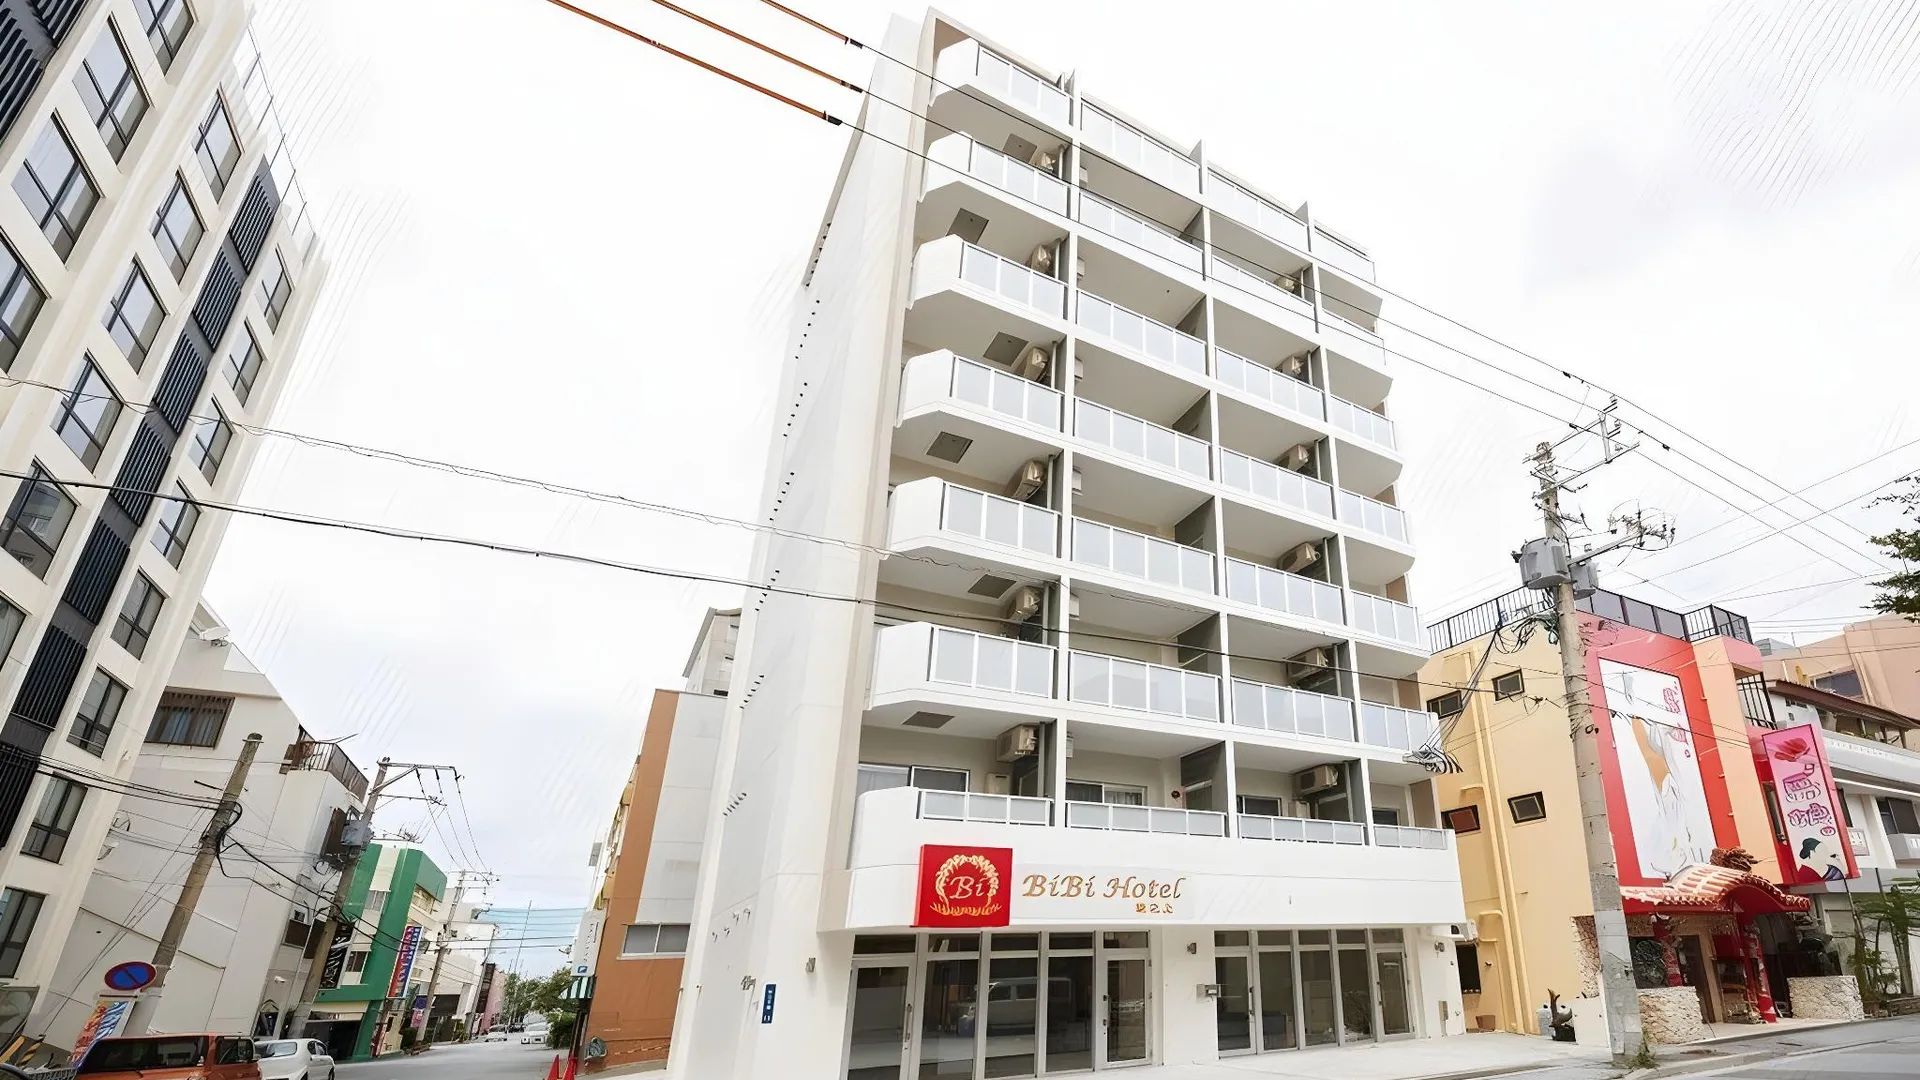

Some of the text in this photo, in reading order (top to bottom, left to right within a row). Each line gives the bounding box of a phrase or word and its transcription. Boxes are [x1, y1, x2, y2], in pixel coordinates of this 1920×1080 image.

[949, 875, 989, 899] Bi
[1022, 874, 1187, 899] BiBi Hotel
